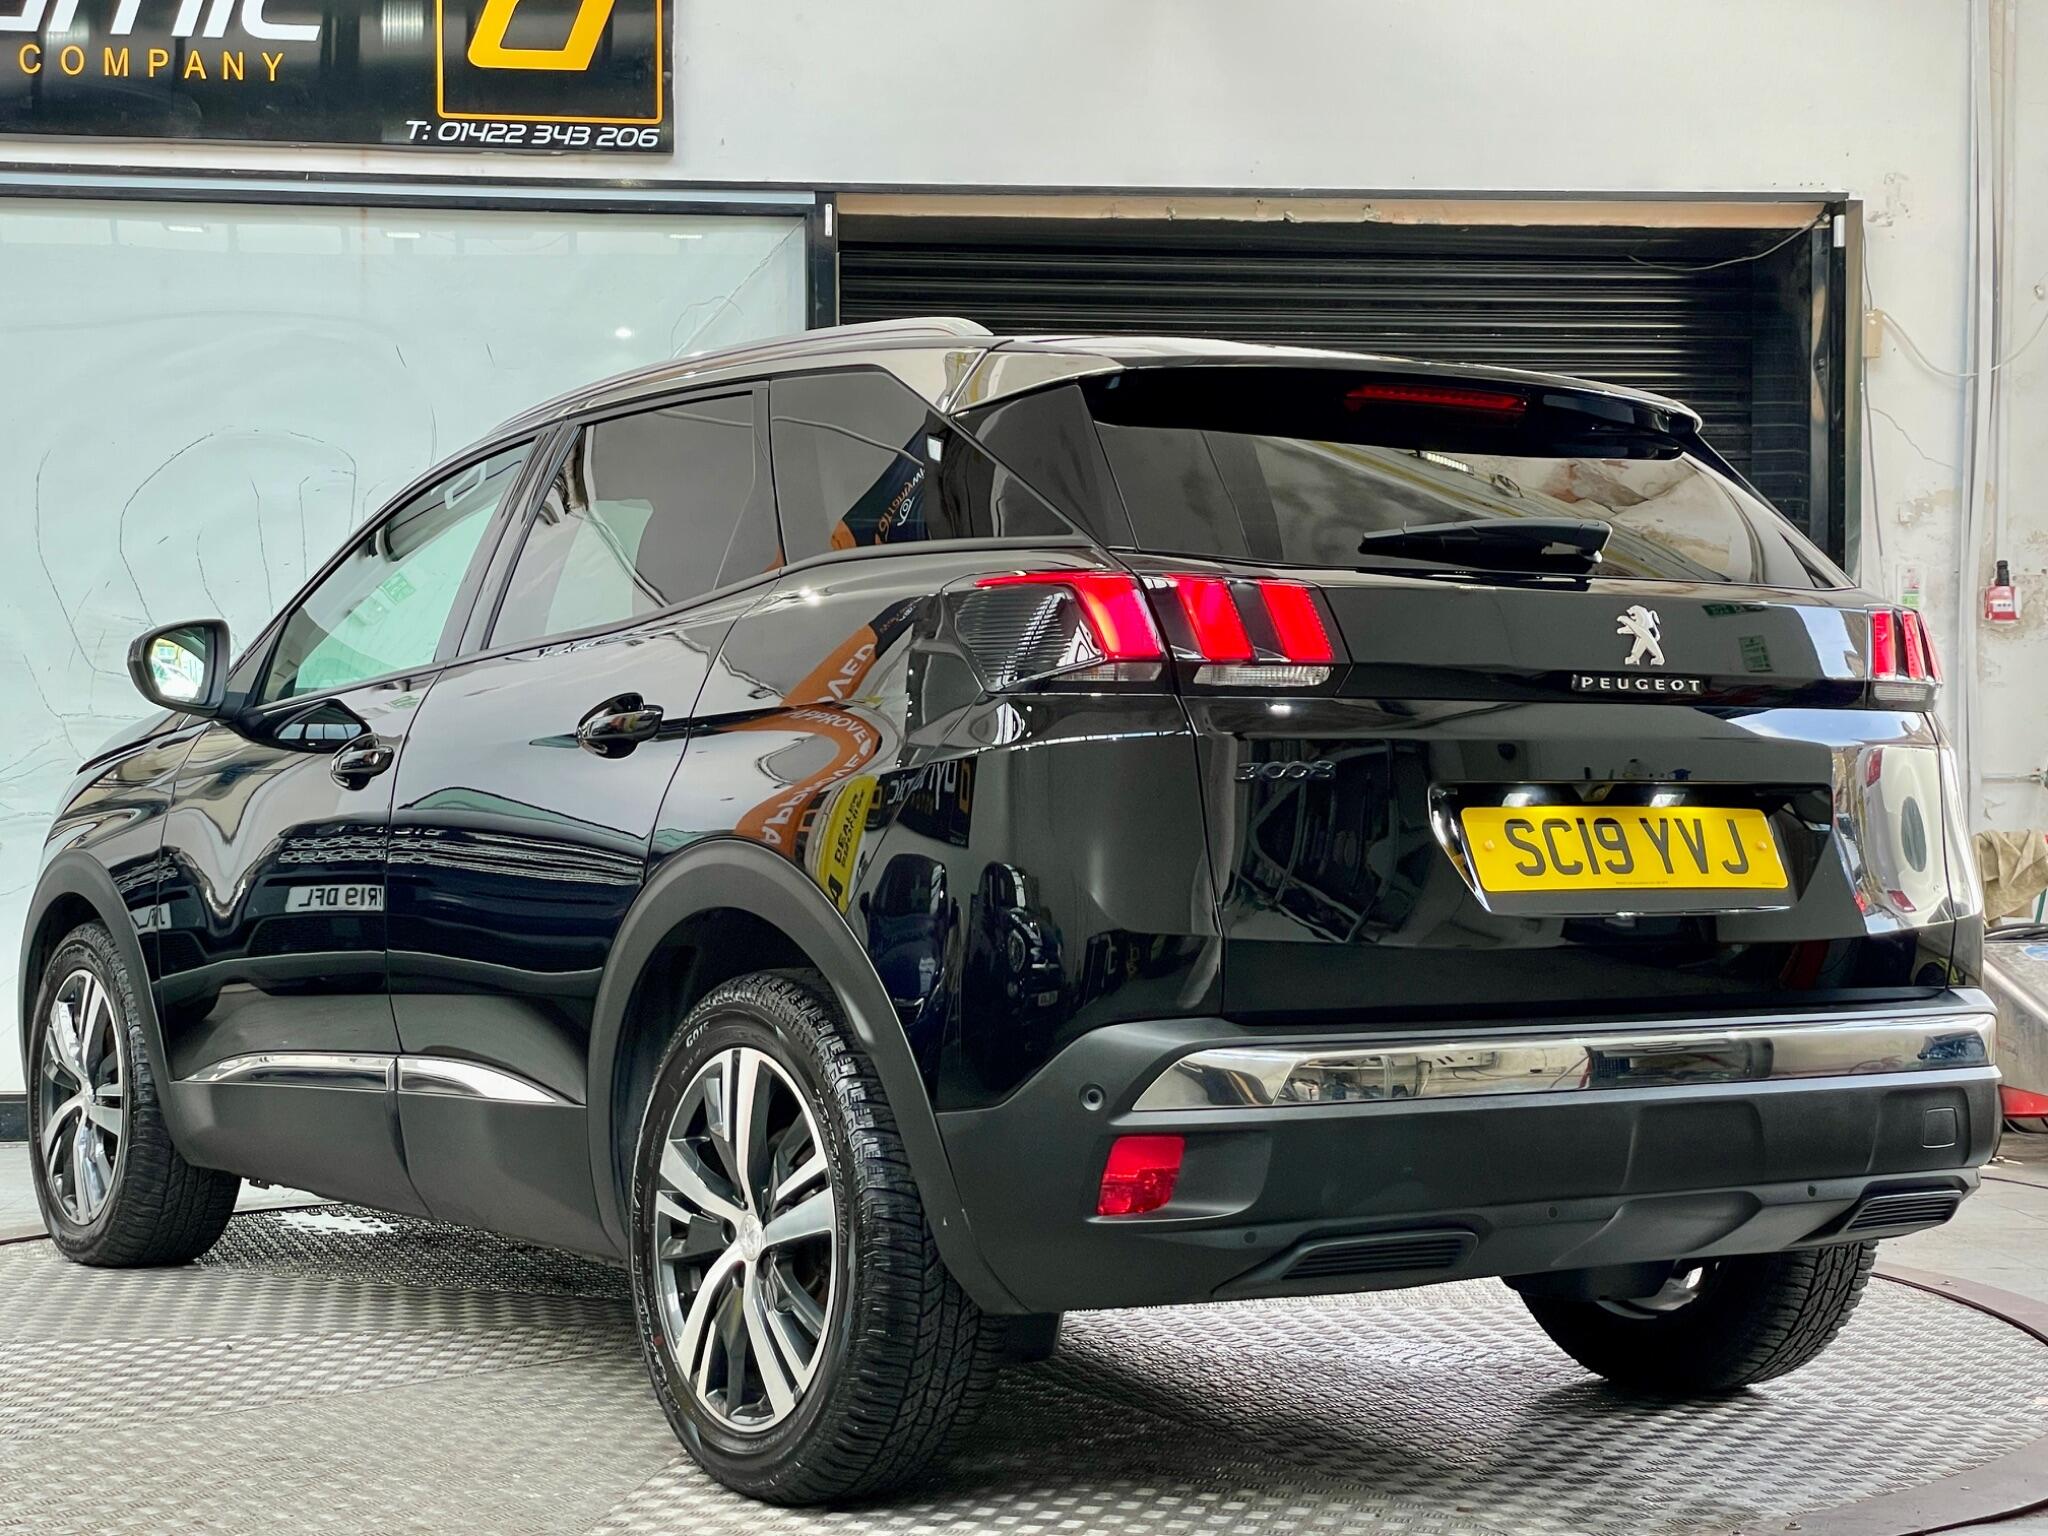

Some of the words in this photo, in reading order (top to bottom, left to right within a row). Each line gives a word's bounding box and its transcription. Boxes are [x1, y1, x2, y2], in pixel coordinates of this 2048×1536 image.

[18, 43, 284, 82] COMPANY
[406, 120, 432, 141] T:
[437, 122, 527, 144] 01422
[531, 125, 590, 146] 343
[596, 127, 660, 147] 206
[1581, 676, 1700, 692] PEUGEOT
[1234, 760, 1336, 780] 3008
[1504, 817, 1635, 876] SC19
[1638, 817, 1749, 875] YVJ
